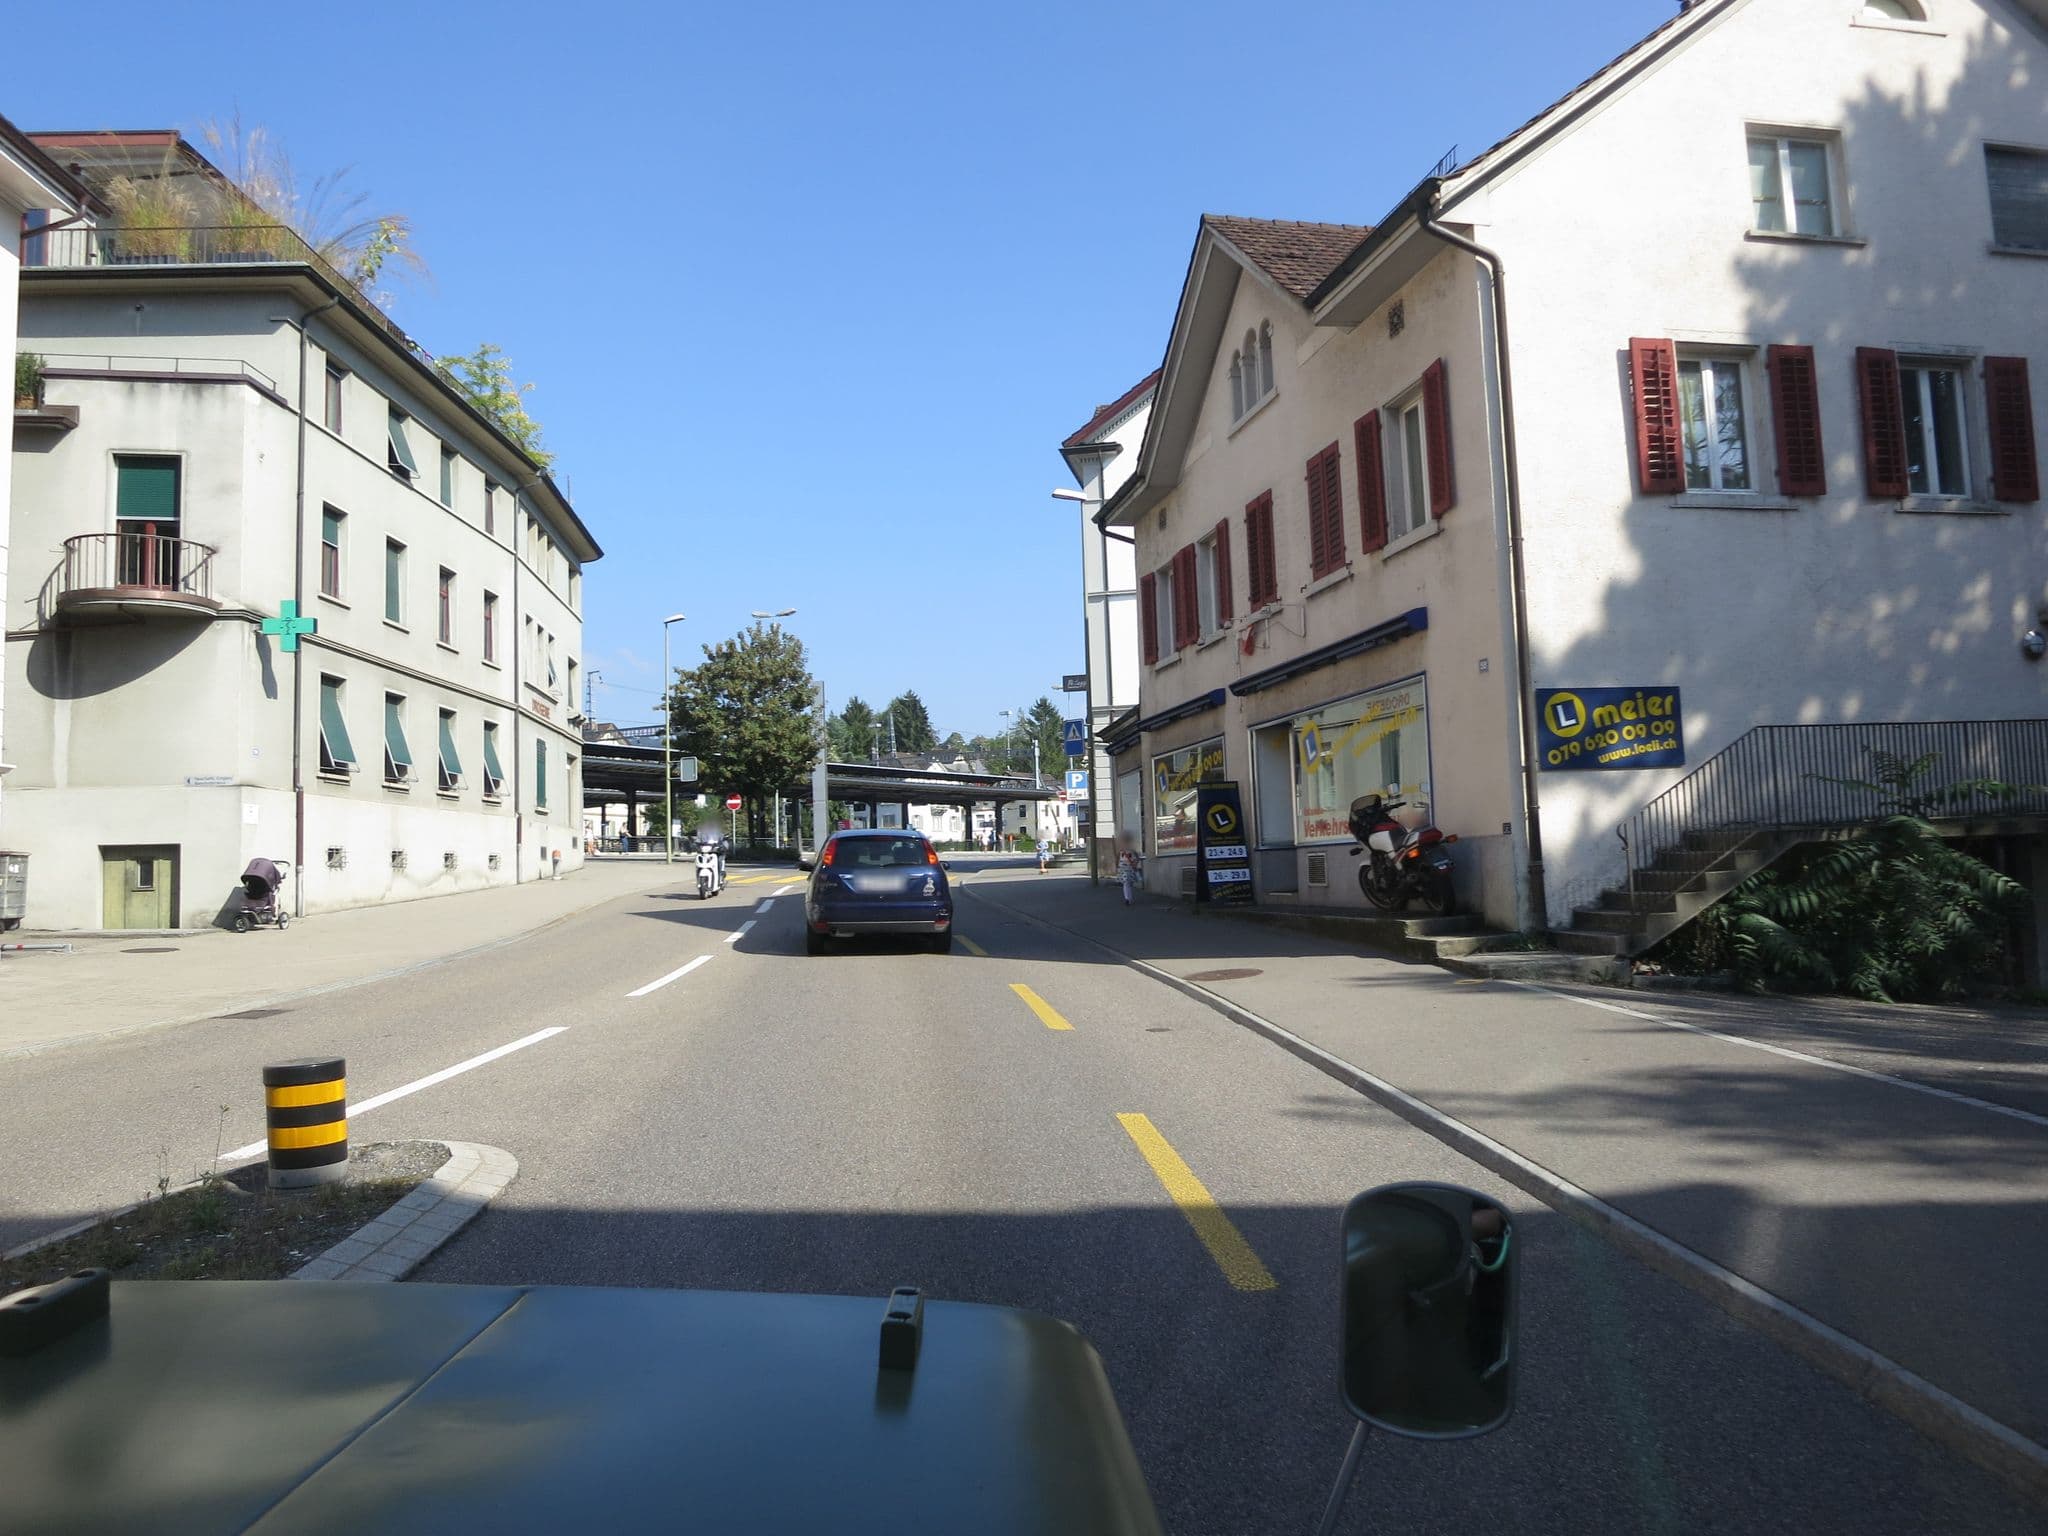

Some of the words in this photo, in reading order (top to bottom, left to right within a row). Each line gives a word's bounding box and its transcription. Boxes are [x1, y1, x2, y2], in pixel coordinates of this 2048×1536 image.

[1592, 691, 1674, 728] meier
[1547, 741, 1581, 765] 079
[1584, 729, 1619, 749] 620
[1622, 723, 1647, 741] 09
[1651, 720, 1676, 736] 09
[1071, 773, 1083, 788] P
